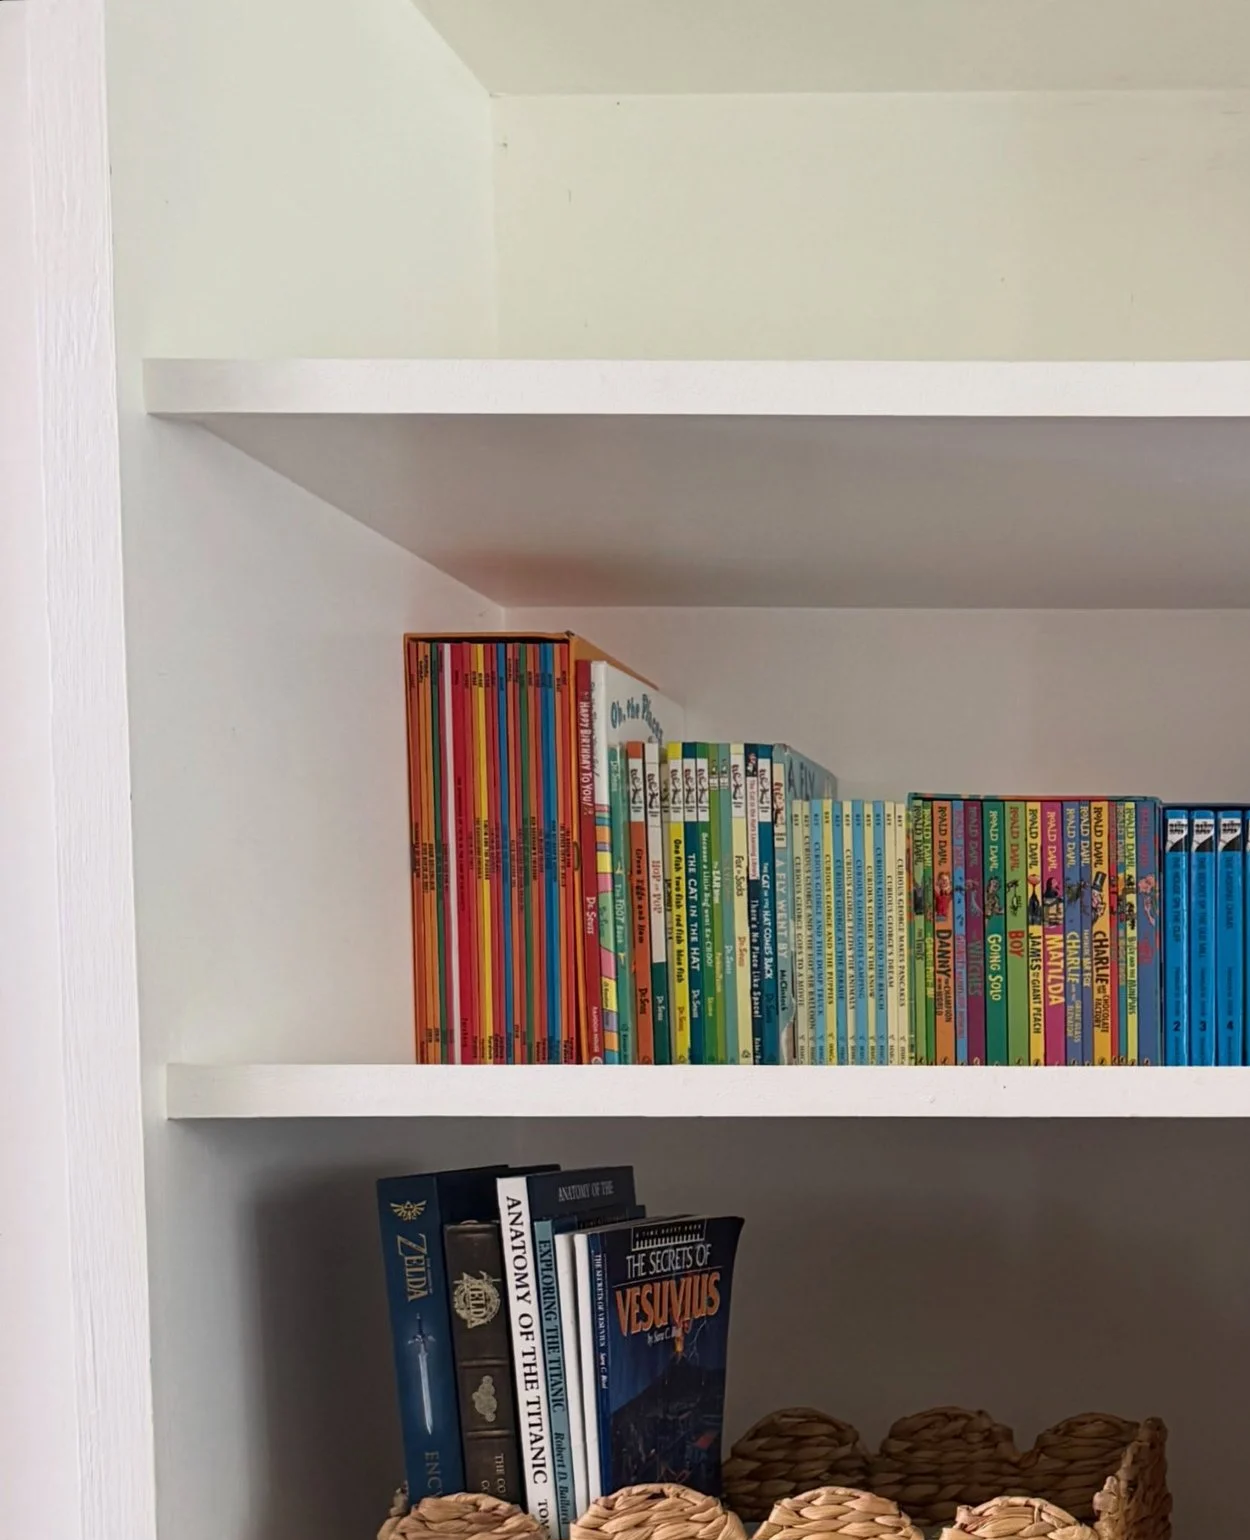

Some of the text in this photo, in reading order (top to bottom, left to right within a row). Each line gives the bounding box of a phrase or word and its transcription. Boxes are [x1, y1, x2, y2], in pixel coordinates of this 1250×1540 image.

[689, 879, 697, 900] CAT
[776, 873, 786, 893] FLY
[616, 899, 624, 923] FOOT
[690, 906, 697, 916] IN
[777, 900, 788, 939] WENT
[691, 947, 699, 971] HAT
[779, 944, 788, 958] BY
[936, 930, 951, 978] DANNY
[987, 934, 1002, 971] GOING
[1008, 930, 1025, 958] BOY
[1093, 931, 1108, 984] CHARLIE
[1045, 934, 1064, 1005] MATILDA
[397, 1233, 429, 1302] ZELDA
[506, 1196, 531, 1304] ANATOMY
[626, 1244, 712, 1279] THE SECRETS OF
[538, 1240, 559, 1320] EXPLORING
[616, 1272, 720, 1337] VESUVIUS
[518, 1313, 535, 1341] OF
[546, 1325, 560, 1354] THE
[521, 1347, 538, 1391] THE
[548, 1357, 564, 1412] TITANIC
[526, 1396, 547, 1484] TITANIC
[554, 1432, 568, 1468] Robert
